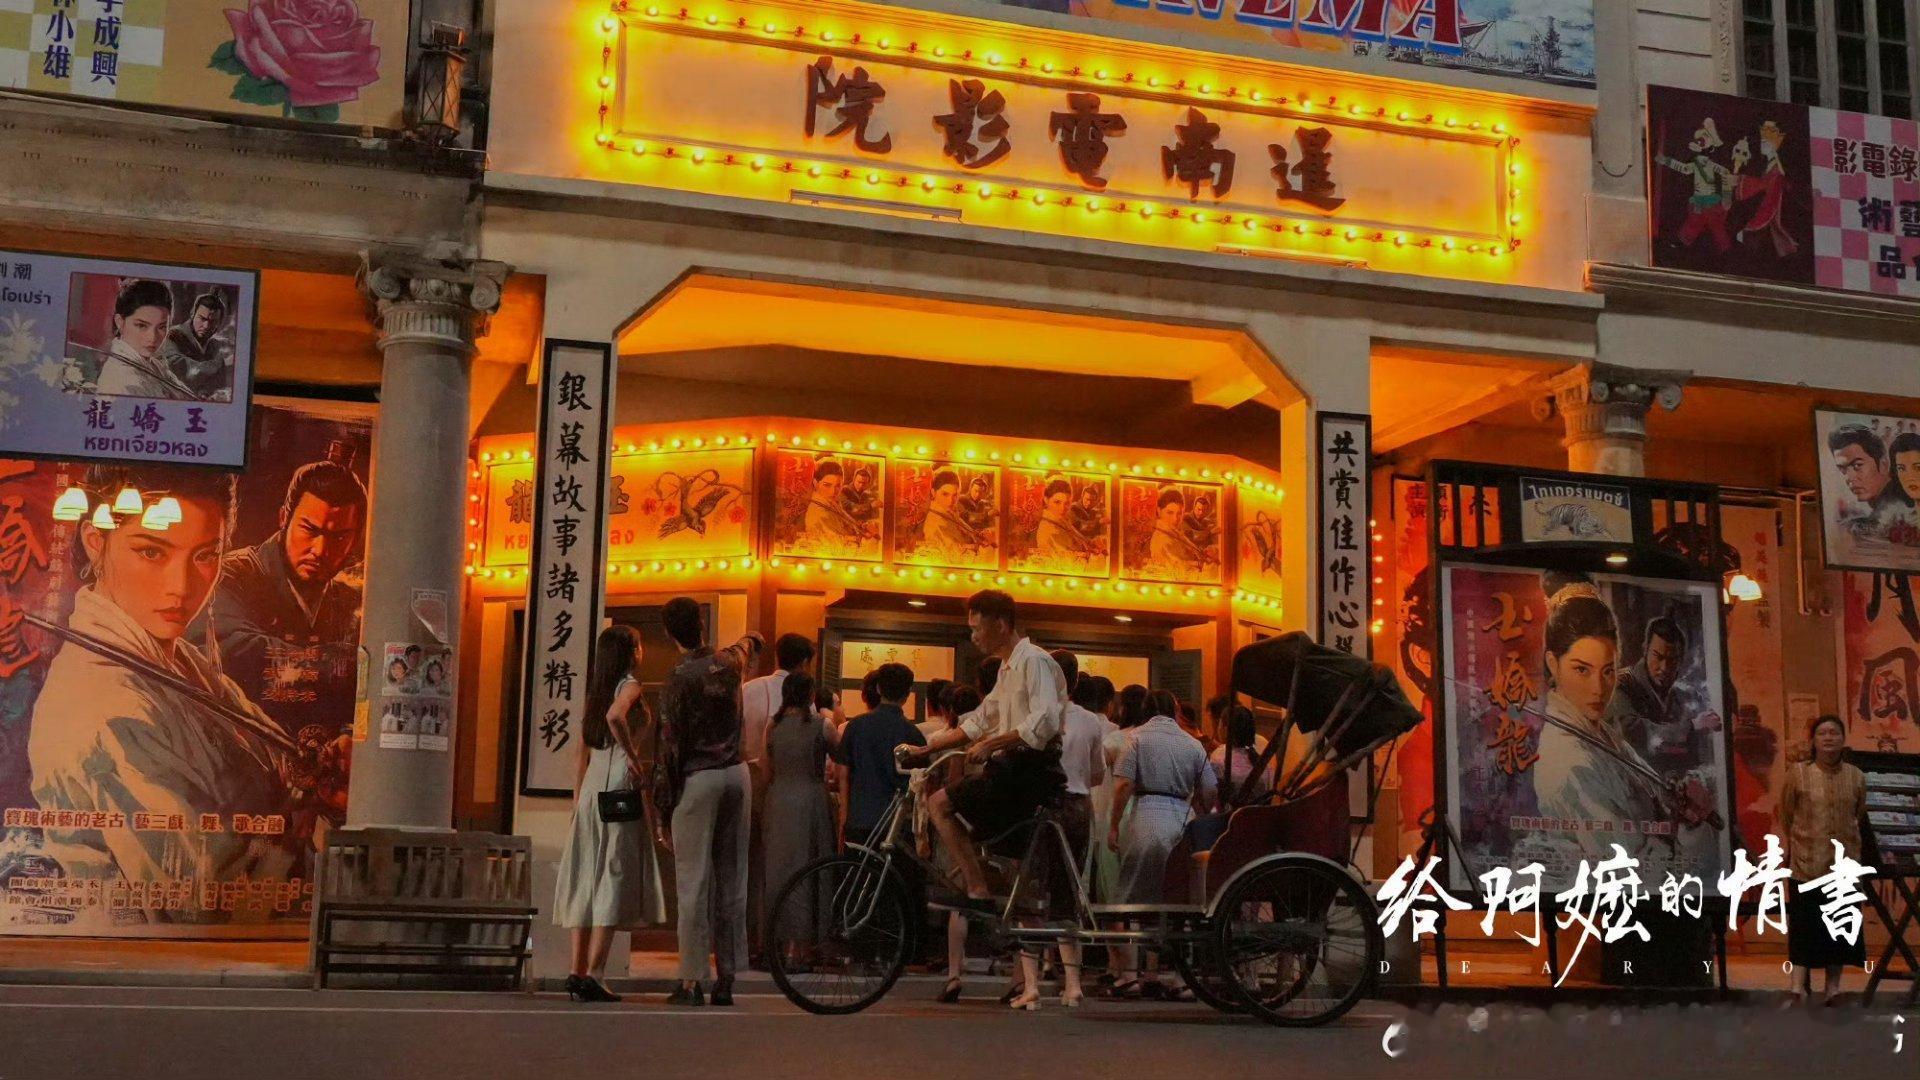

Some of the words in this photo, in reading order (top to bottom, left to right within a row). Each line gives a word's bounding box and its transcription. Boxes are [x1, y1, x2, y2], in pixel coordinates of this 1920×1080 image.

[43, 0, 76, 79] 小雄
[538, 371, 593, 753] 銀幕故事諸多精彩
